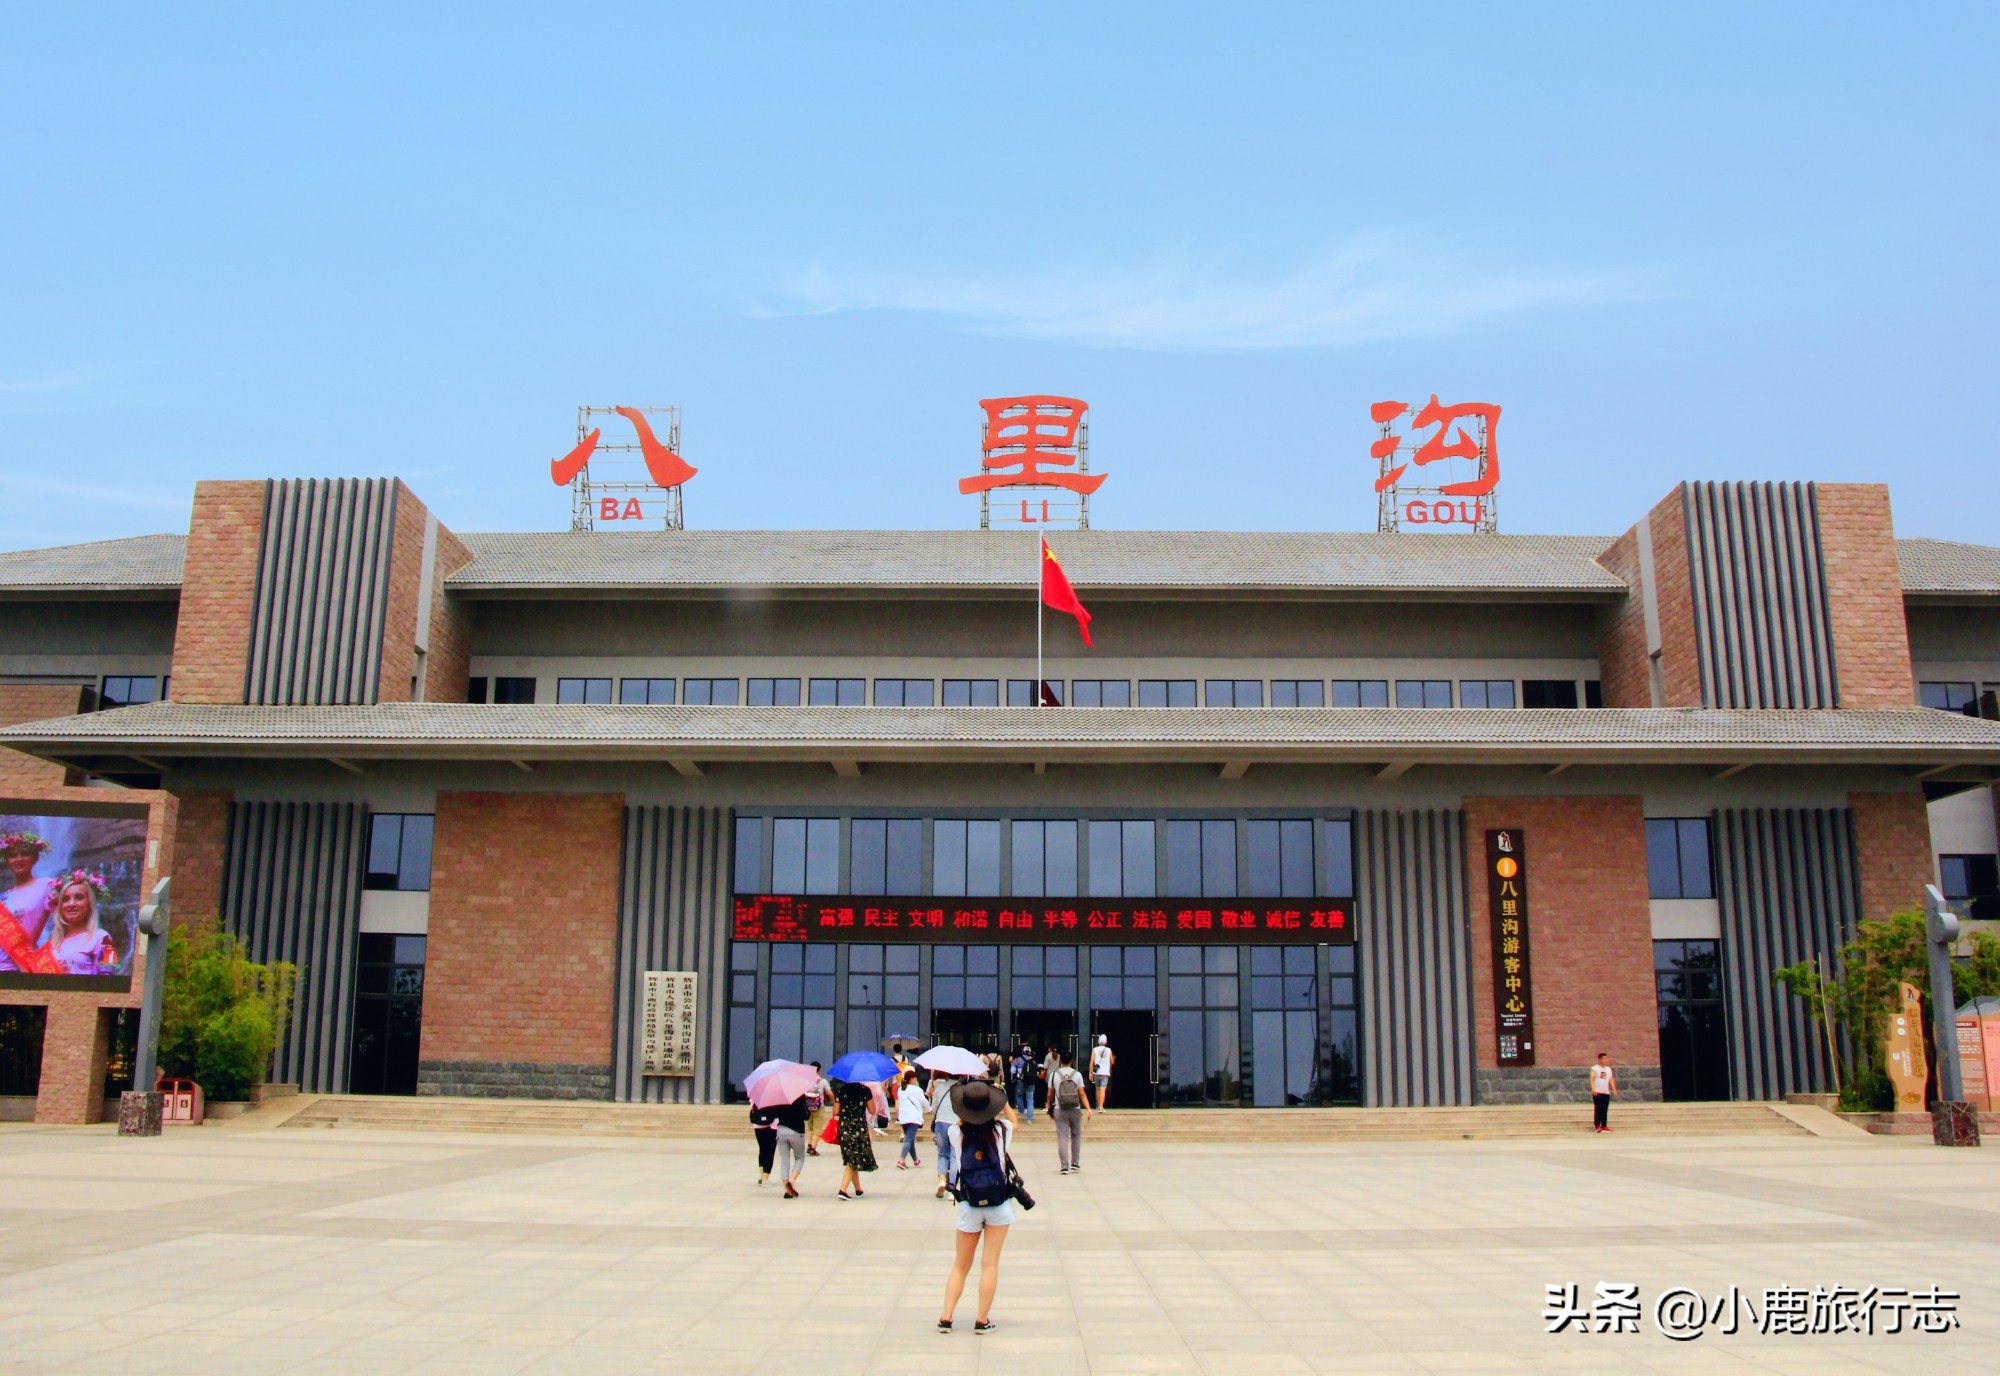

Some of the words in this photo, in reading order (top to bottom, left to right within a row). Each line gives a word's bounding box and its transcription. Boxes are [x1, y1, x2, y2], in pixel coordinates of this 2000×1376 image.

[551, 405, 698, 487] 八
[958, 395, 1109, 495] 里
[1370, 394, 1502, 496] 沟
[600, 498, 643, 520] BA
[1022, 500, 1047, 522] LI
[1406, 500, 1481, 524] GOU
[820, 909, 853, 926] 富强
[864, 909, 898, 926] 民主
[908, 909, 943, 927] 文明
[953, 910, 988, 928] 和谐
[999, 910, 1032, 928] 自由
[1043, 910, 1078, 928] 平等
[1087, 910, 1121, 928] 公正
[1132, 910, 1167, 928] 法治
[1177, 910, 1211, 928] 爱国
[1221, 910, 1255, 928] 敬业
[1266, 910, 1300, 928] 诚信
[1310, 910, 1344, 928] 友善
[1500, 880, 1524, 1013] 八里沟游客中心
